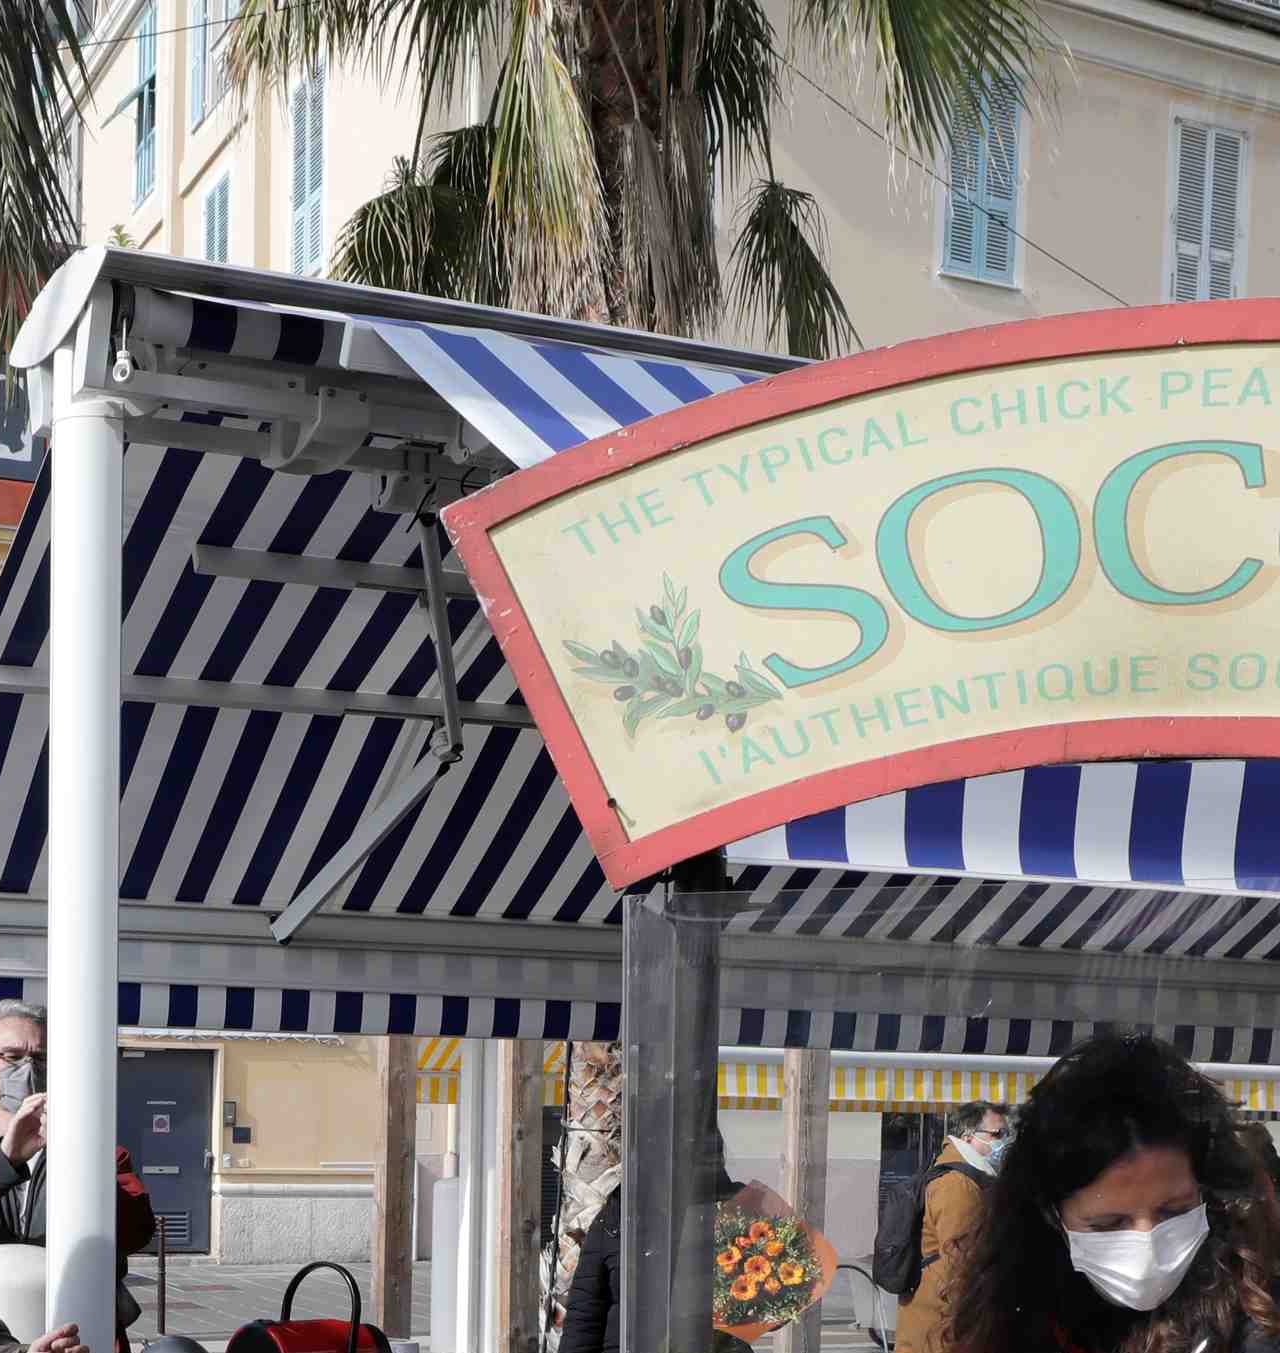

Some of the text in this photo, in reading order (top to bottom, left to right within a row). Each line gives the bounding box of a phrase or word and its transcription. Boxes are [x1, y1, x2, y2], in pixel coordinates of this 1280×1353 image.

[560, 487, 675, 556] THE
[680, 408, 928, 507] TYPICAL
[949, 374, 1136, 436] CHICK
[1159, 366, 1273, 411] PEA
